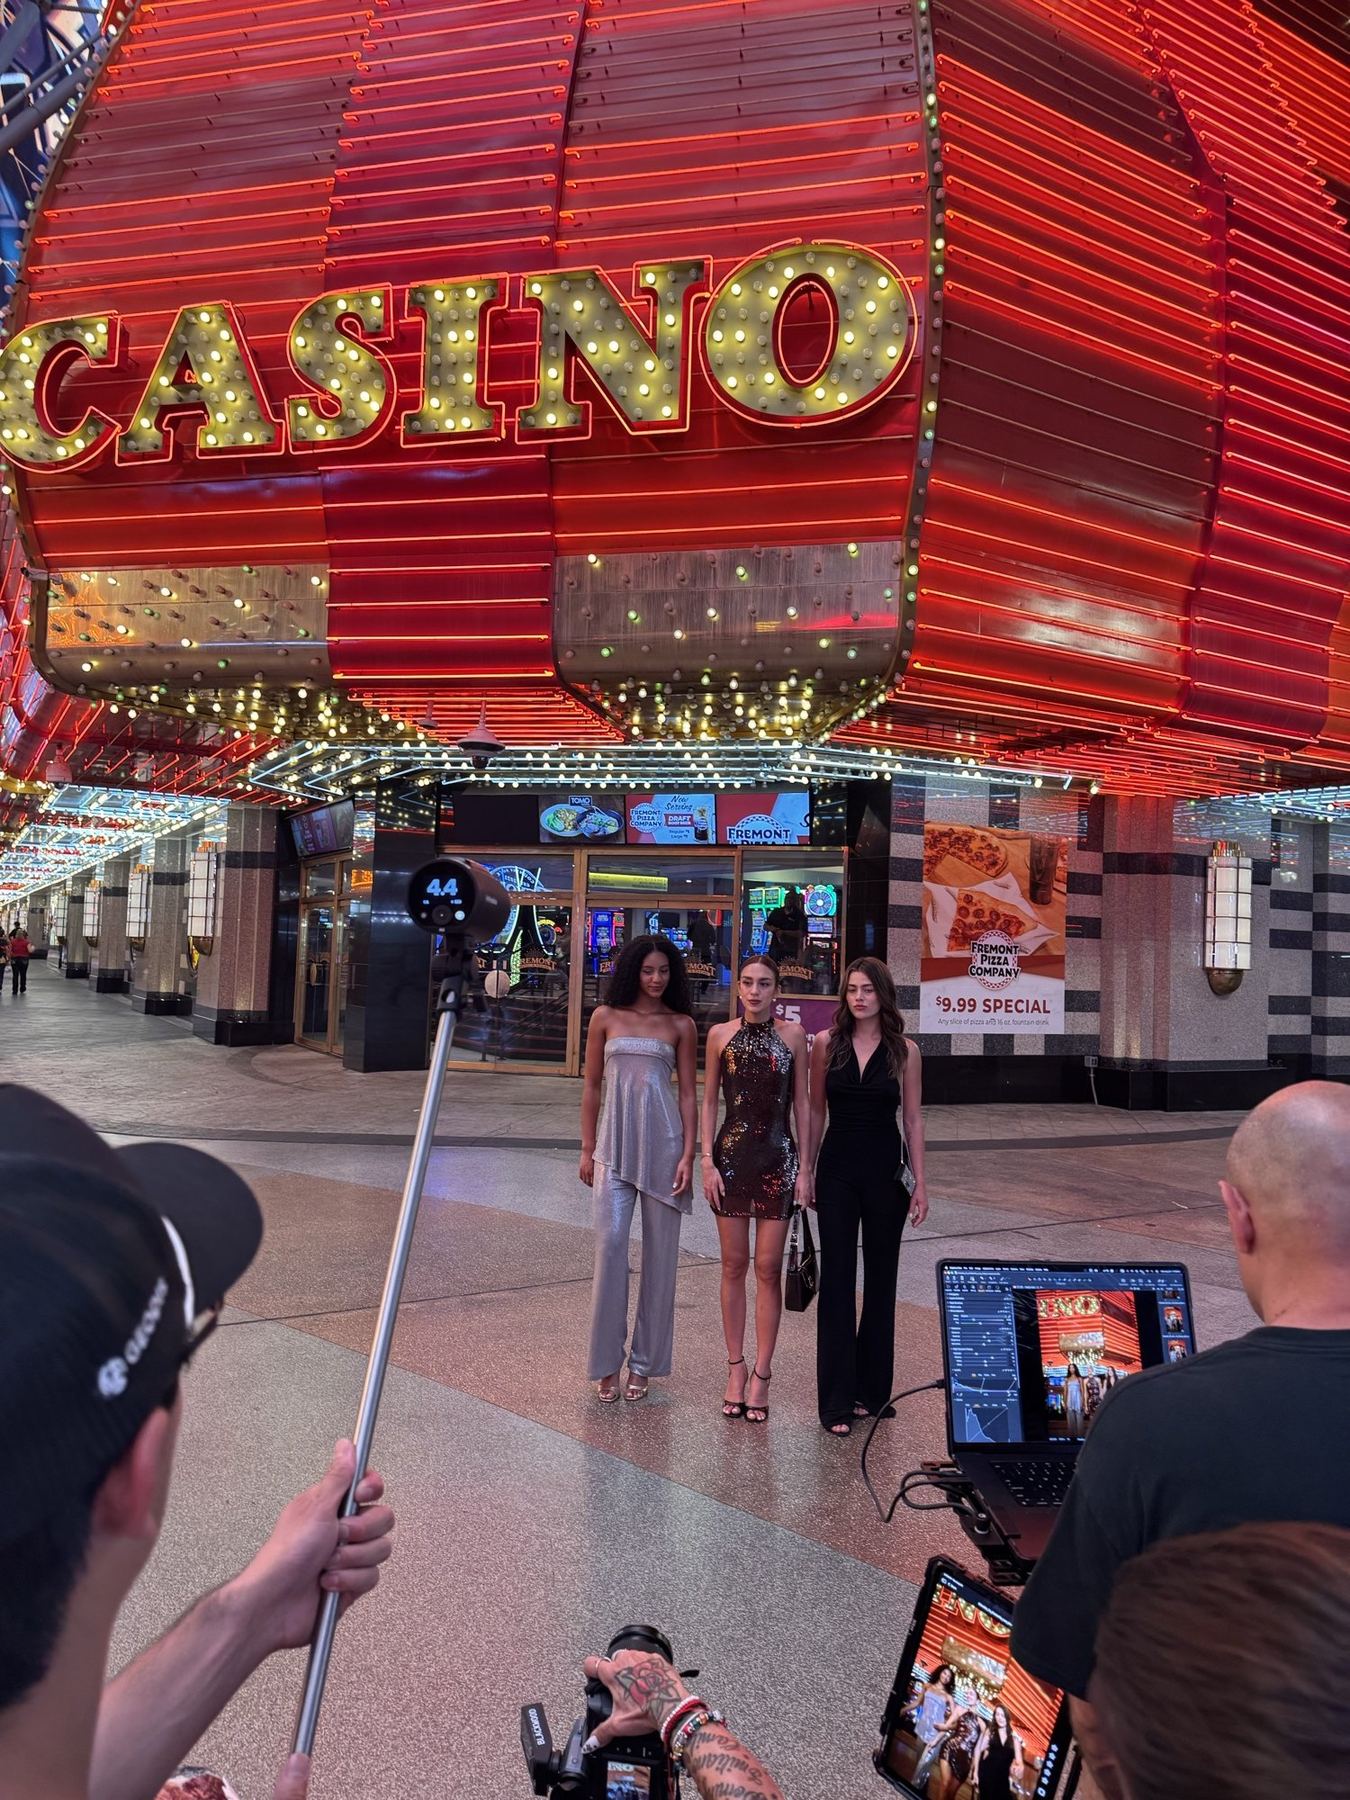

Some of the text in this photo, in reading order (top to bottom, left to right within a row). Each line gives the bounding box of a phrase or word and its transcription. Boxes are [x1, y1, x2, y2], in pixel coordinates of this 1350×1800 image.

[0, 238, 919, 472] CASINO
[571, 797, 591, 805] TOMO
[728, 828, 790, 840] FREMONT
[426, 878, 458, 896] 4.4
[971, 942, 1019, 955] FREMONT
[519, 957, 557, 971] REMONT
[980, 954, 1009, 966] PIZZA
[779, 964, 815, 980] EMONT
[970, 965, 1020, 978] COMPANY
[936, 995, 1051, 1014] $9.99 SPECIAL
[775, 1003, 801, 1024] $5
[938, 1018, 949, 1026] Any
